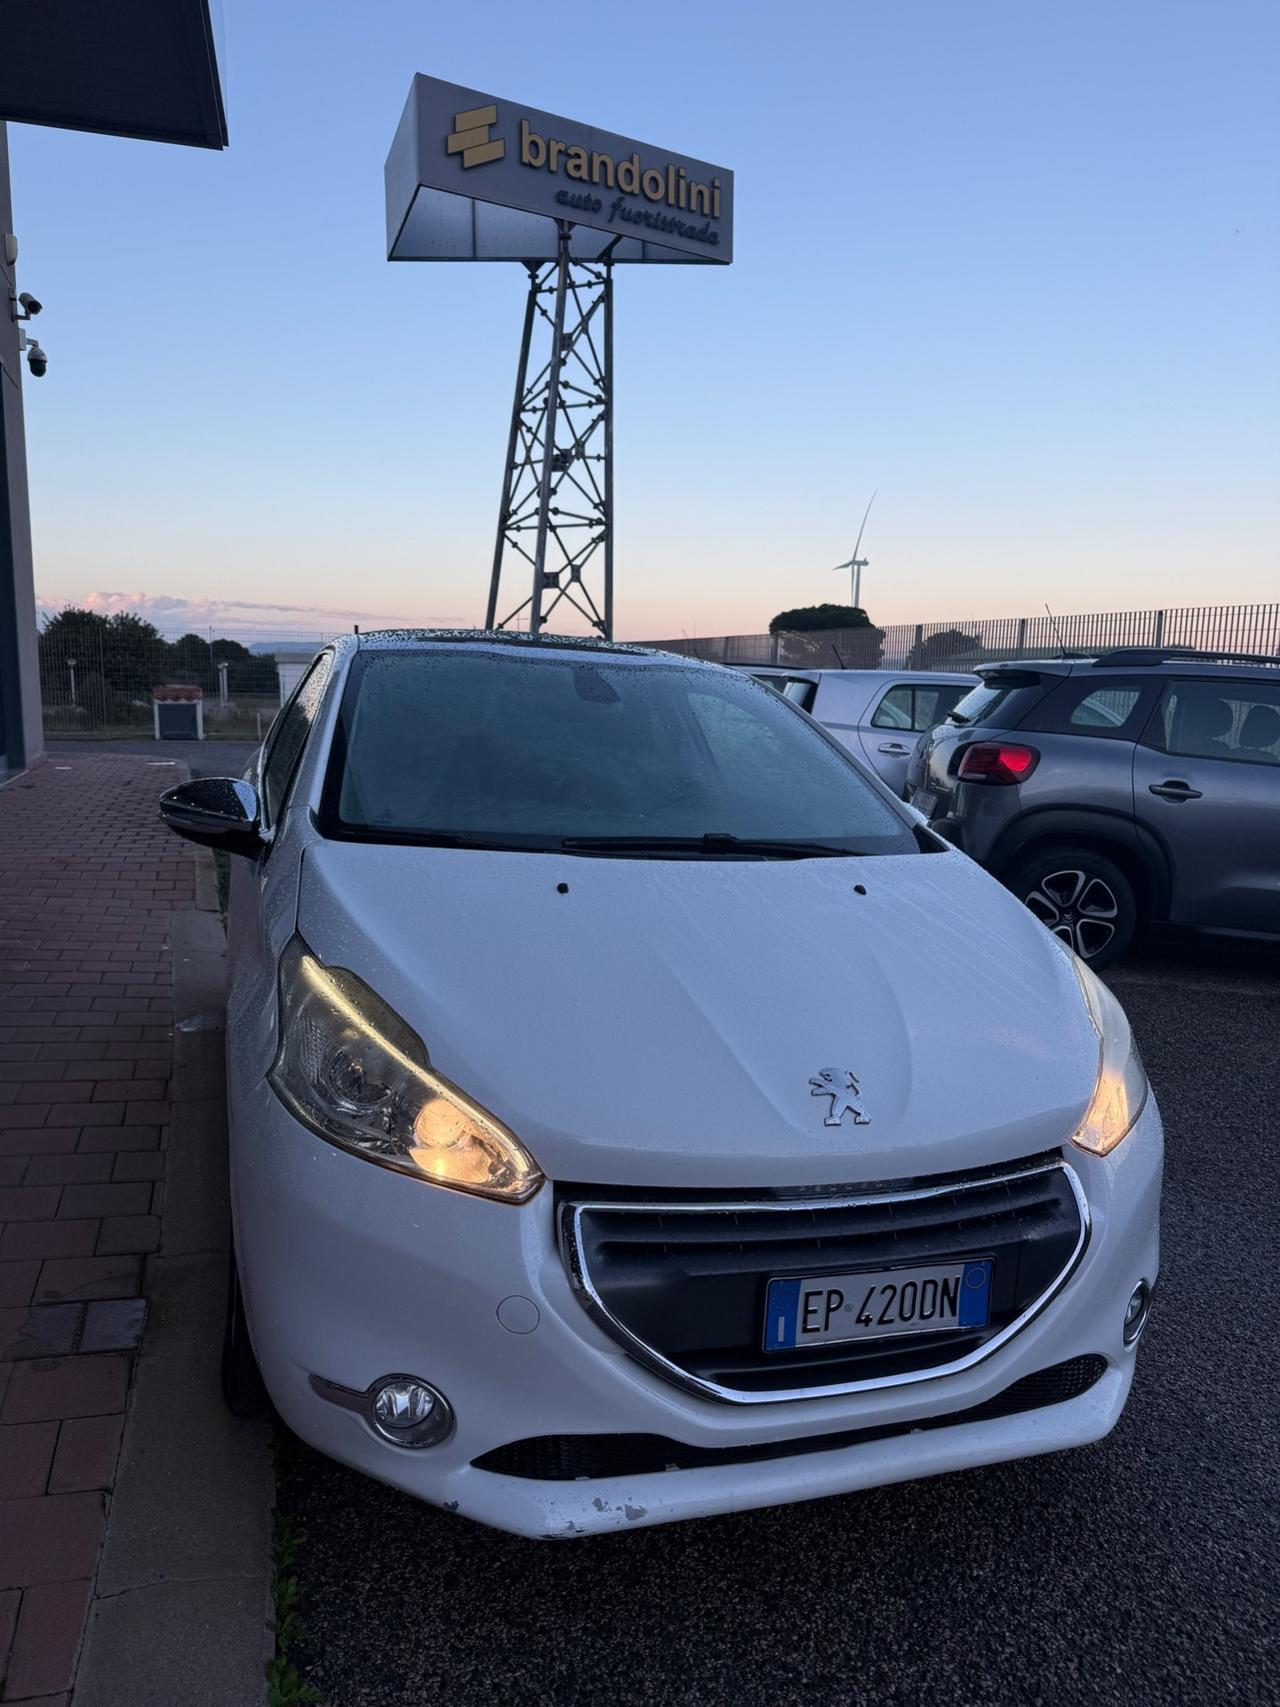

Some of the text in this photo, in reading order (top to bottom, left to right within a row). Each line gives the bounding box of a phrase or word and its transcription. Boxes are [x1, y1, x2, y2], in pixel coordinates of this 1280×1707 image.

[520, 118, 721, 218] brandolini
[555, 189, 721, 246] auto fuoristrada
[802, 1289, 844, 1334] EP
[855, 1275, 961, 1327] 420DN
